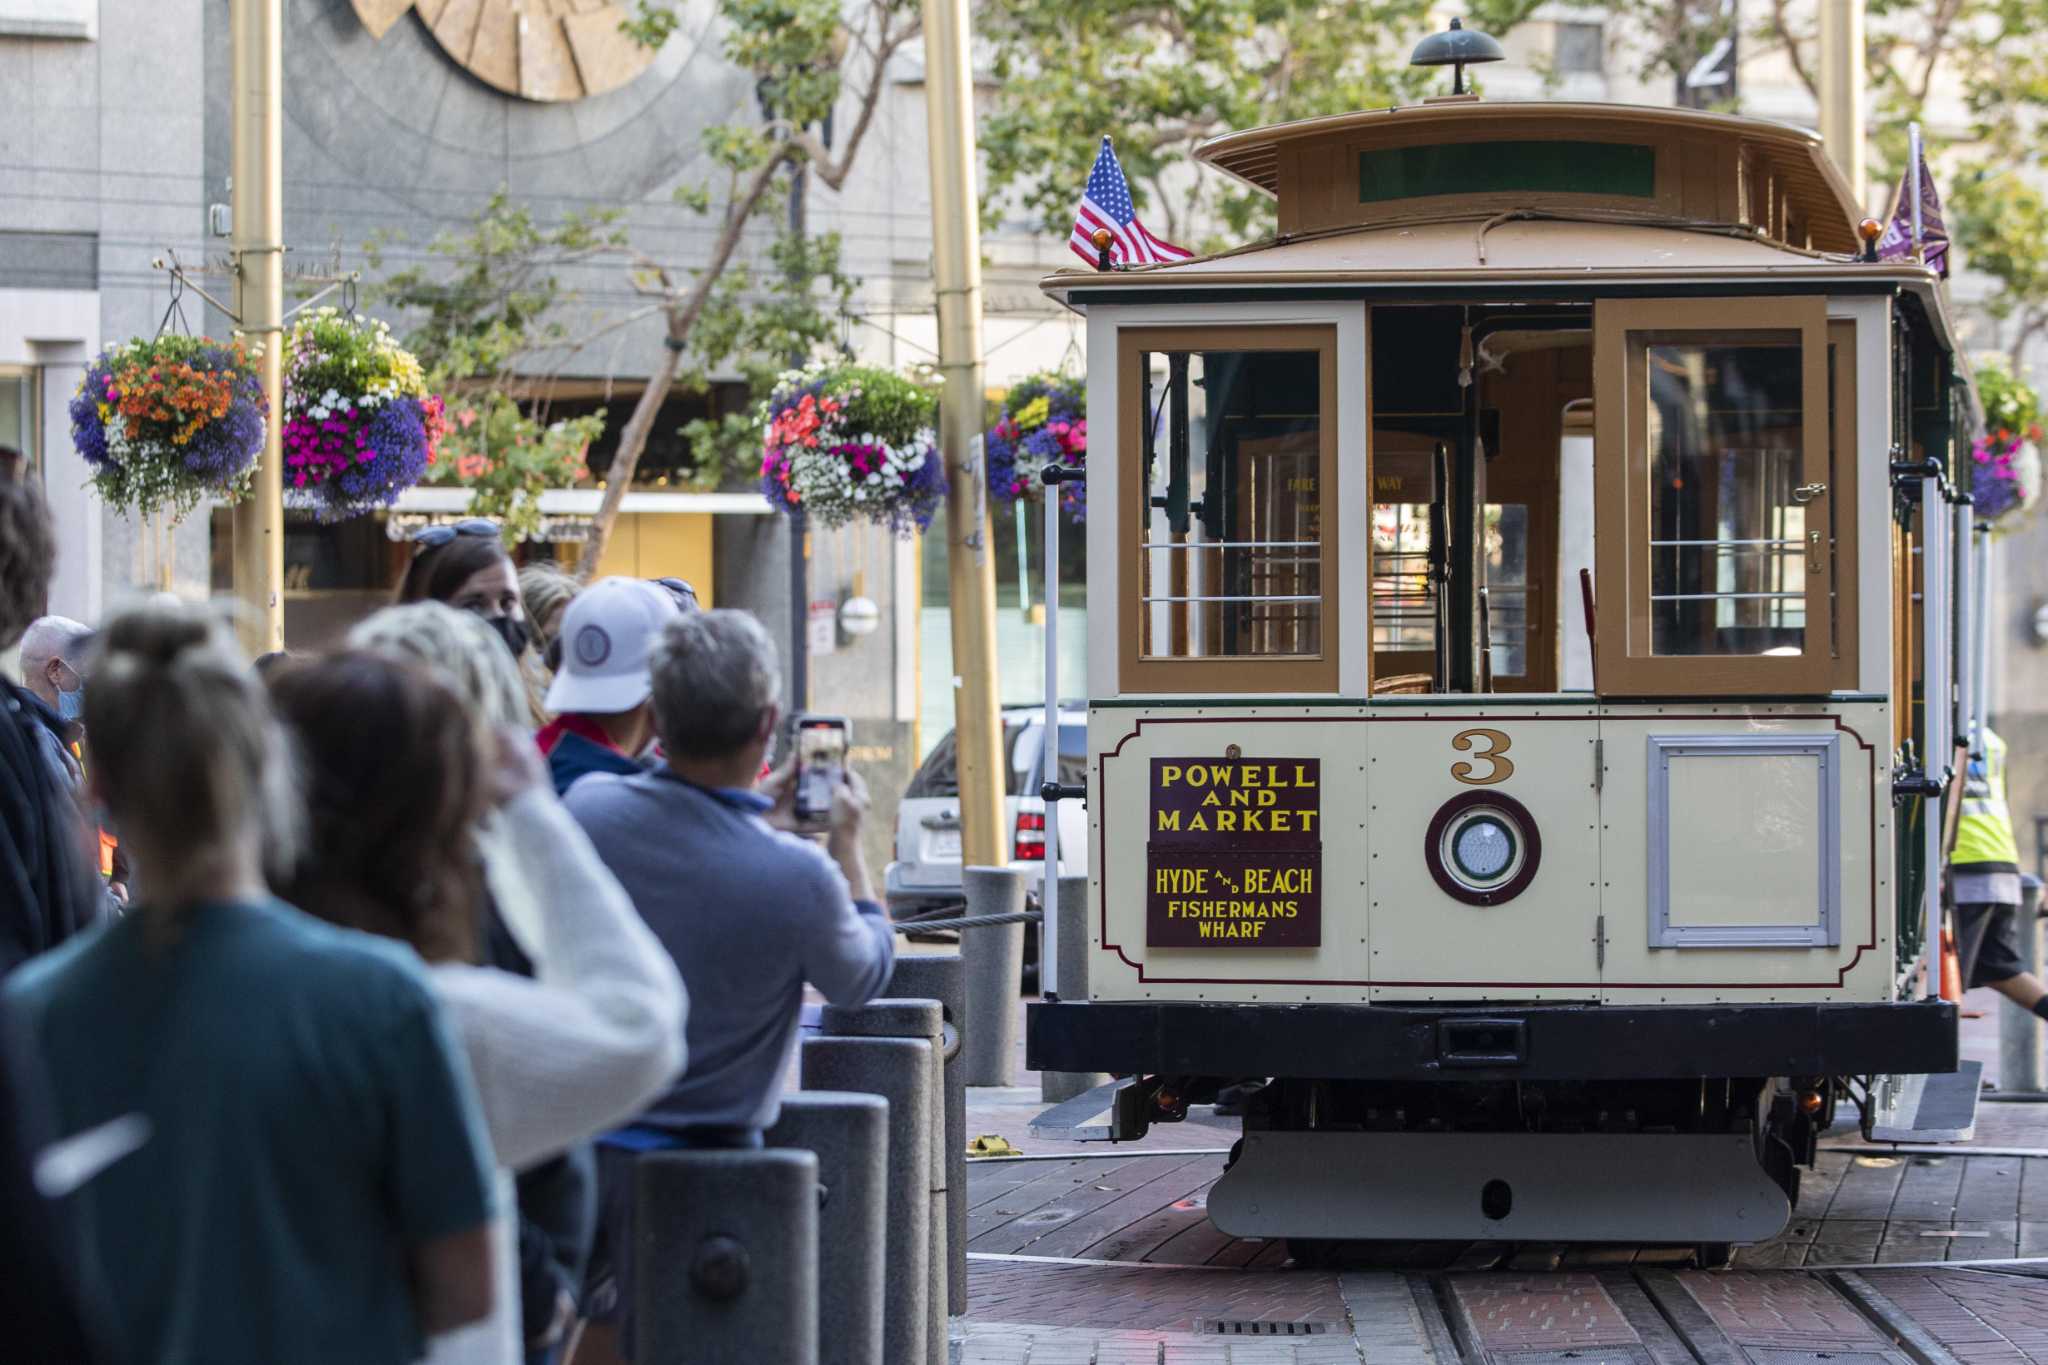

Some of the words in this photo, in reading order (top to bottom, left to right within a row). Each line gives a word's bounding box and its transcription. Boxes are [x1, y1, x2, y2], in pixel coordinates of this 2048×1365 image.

[1377, 477, 1403, 490] WAY
[1450, 728, 1514, 785] 3
[1161, 764, 1316, 788] POWELL
[1201, 789, 1278, 807] AND
[1157, 809, 1318, 832] MARKET
[1156, 868, 1209, 894] HYDE
[1215, 869, 1240, 894] AND
[1244, 868, 1313, 894] BEACH
[1168, 900, 1298, 918] FISHERMANS
[1199, 921, 1267, 938] WHARF
